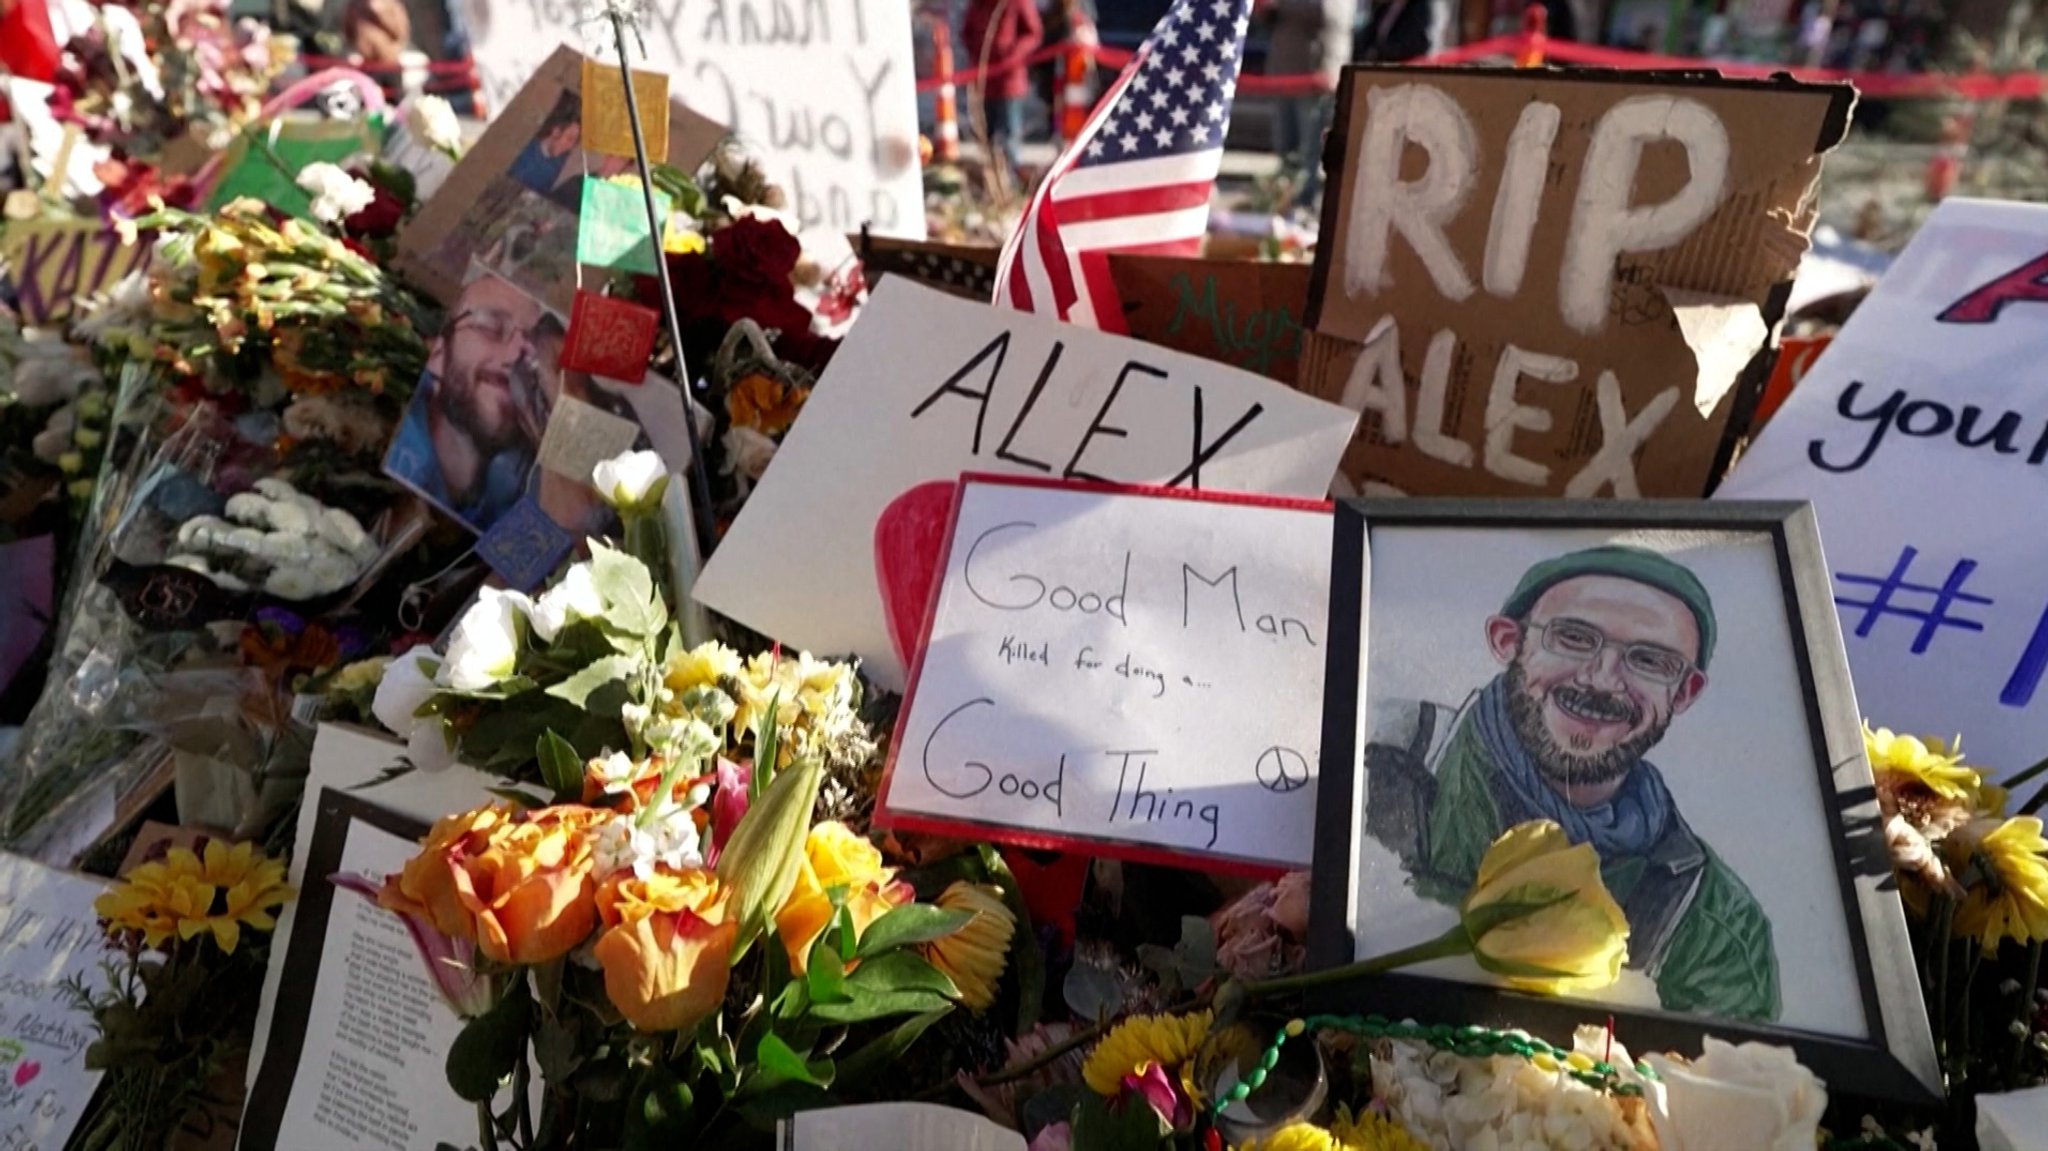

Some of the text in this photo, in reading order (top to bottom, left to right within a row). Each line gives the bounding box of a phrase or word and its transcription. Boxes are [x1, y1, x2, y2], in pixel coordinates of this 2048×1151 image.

[1345, 82, 1730, 336] RIP
[911, 329, 1264, 489] ALEX
[1340, 315, 1681, 499] ALEX
[964, 521, 1318, 647] Good Man
[998, 634, 1048, 668] Killed
[1075, 645, 1102, 669] for
[1115, 653, 1166, 699] doing
[923, 697, 1220, 849] Good Thing
